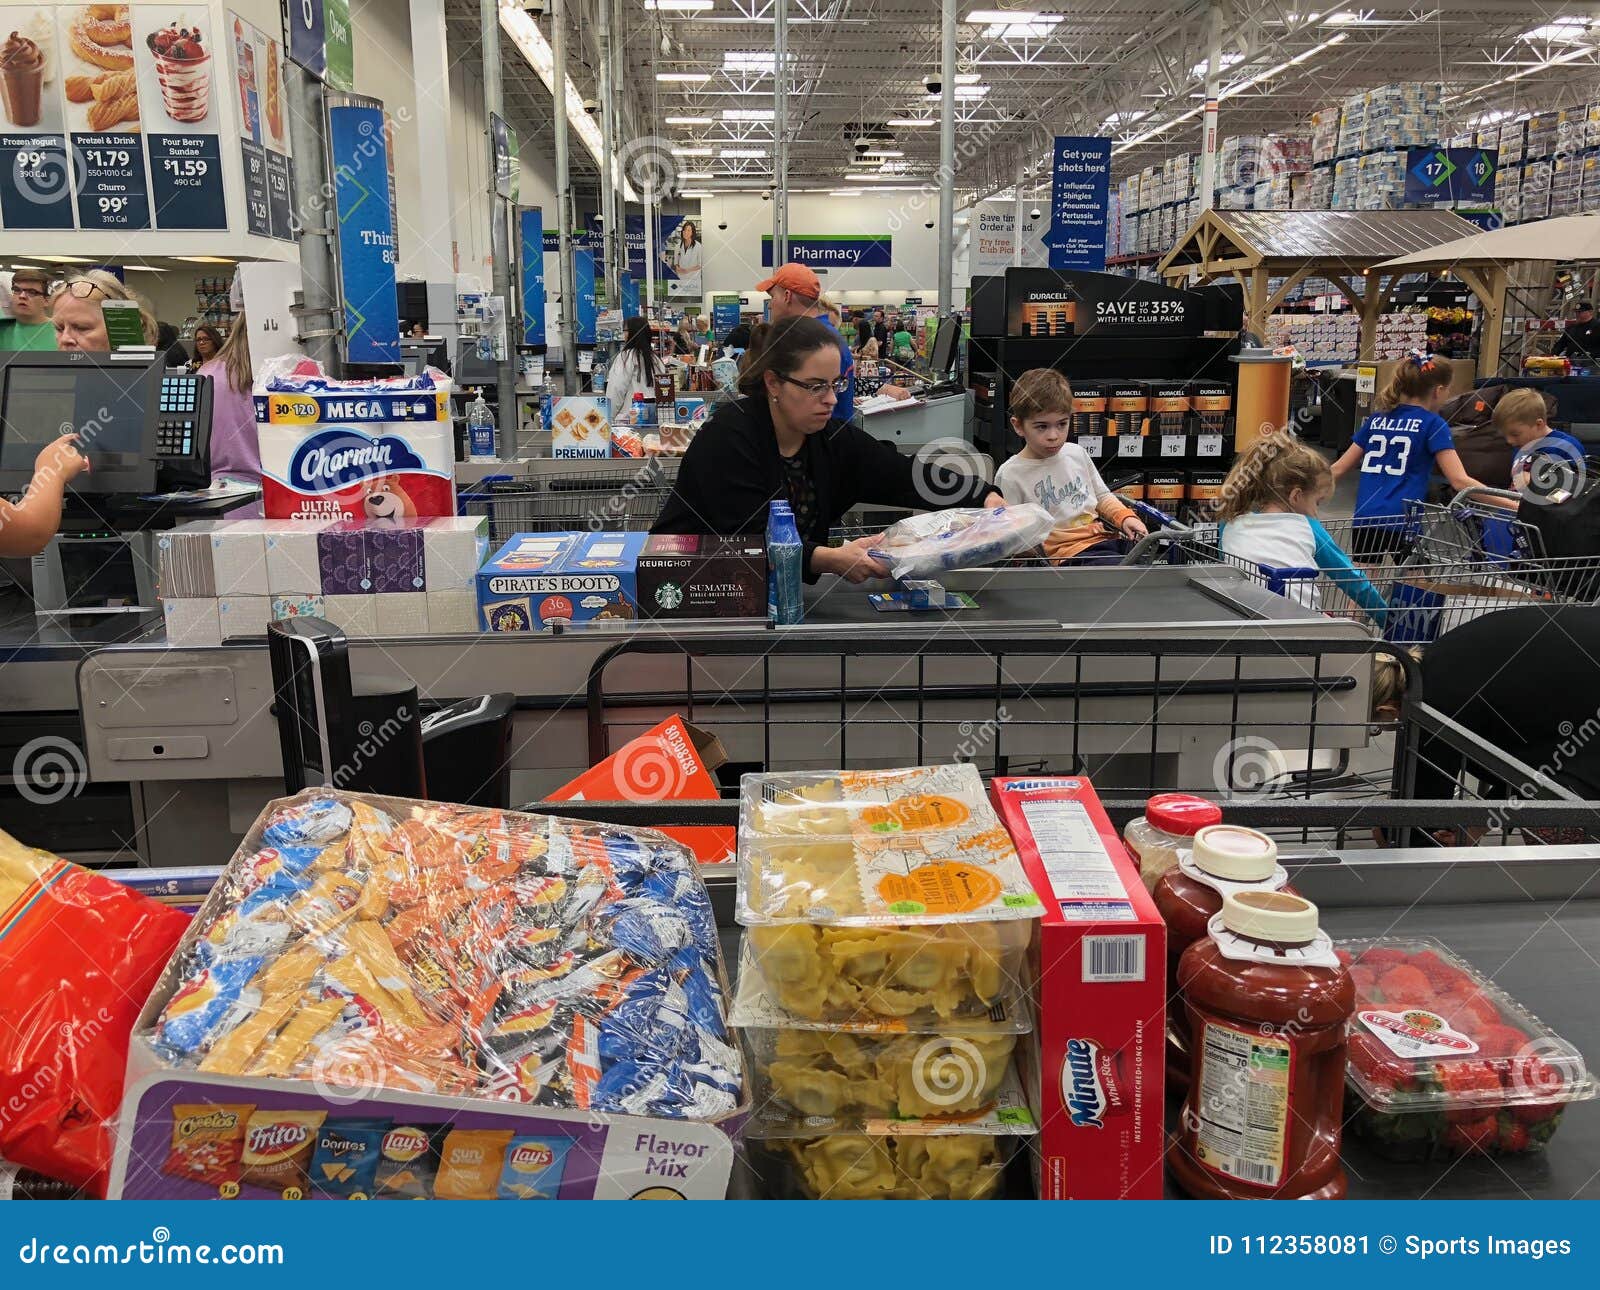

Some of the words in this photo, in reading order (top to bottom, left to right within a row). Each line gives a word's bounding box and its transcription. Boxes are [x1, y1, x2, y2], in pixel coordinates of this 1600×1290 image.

[3, 138, 30, 146] Frozen
[31, 138, 57, 147] Yogurt
[77, 137, 104, 145] Pretzel
[106, 137, 112, 145] &
[114, 137, 136, 145] Drink
[162, 137, 181, 147] Four
[183, 137, 204, 149] Berry
[169, 147, 199, 156] Sundae
[1063, 150, 1079, 159] Get
[1081, 151, 1102, 161] your
[86, 150, 130, 167] $1.79
[88, 169, 120, 177] 550-1010
[121, 169, 133, 177] Cal
[164, 160, 208, 176] $1.59
[1058, 163, 1083, 172] shots
[1085, 163, 1105, 172] here
[1426, 163, 1442, 175] 17
[1474, 163, 1485, 175] 18
[174, 178, 188, 187] 490
[189, 178, 201, 187] Cal
[1063, 192, 1091, 201] Shingles
[1062, 202, 1100, 210] Pneumonia
[102, 215, 115, 223] 310
[116, 215, 128, 223] Cal
[980, 214, 1000, 222] Save
[980, 223, 1004, 231] Order
[980, 239, 992, 247] Try
[793, 247, 861, 262] Pharmacy
[980, 246, 997, 254] Club
[1096, 301, 1136, 314] SAVE
[1151, 301, 1184, 314] 35%
[327, 402, 384, 418] MEGA
[1370, 417, 1422, 433] KALLIE
[555, 448, 606, 458] PREMIUM
[1361, 434, 1412, 476] 23
[301, 438, 393, 482] Charmin
[301, 501, 341, 512] ULTRA
[495, 577, 558, 592] PIRATE'S
[561, 577, 614, 590] BOOTY
[690, 584, 743, 592] SUMATRA
[549, 599, 564, 609] 36
[665, 724, 698, 776] 80308789
[918, 871, 943, 906] RAVIOLI
[1135, 1020, 1143, 1044] GRAIN
[1232, 1032, 1249, 1044] Facts
[1135, 1046, 1143, 1067] LONG
[1236, 1058, 1248, 1067] 70
[1101, 1055, 1112, 1077] Rice
[1067, 1039, 1104, 1128] Minute
[1105, 1078, 1122, 1106] White
[179, 1111, 238, 1136] Cheetos
[1134, 1110, 1142, 1143] INSTANT
[250, 1124, 306, 1150] Fritos
[321, 1139, 366, 1151] Doritos
[635, 1133, 708, 1158] Flavor
[645, 1157, 688, 1178] Mix
[287, 1191, 300, 1200] 10
